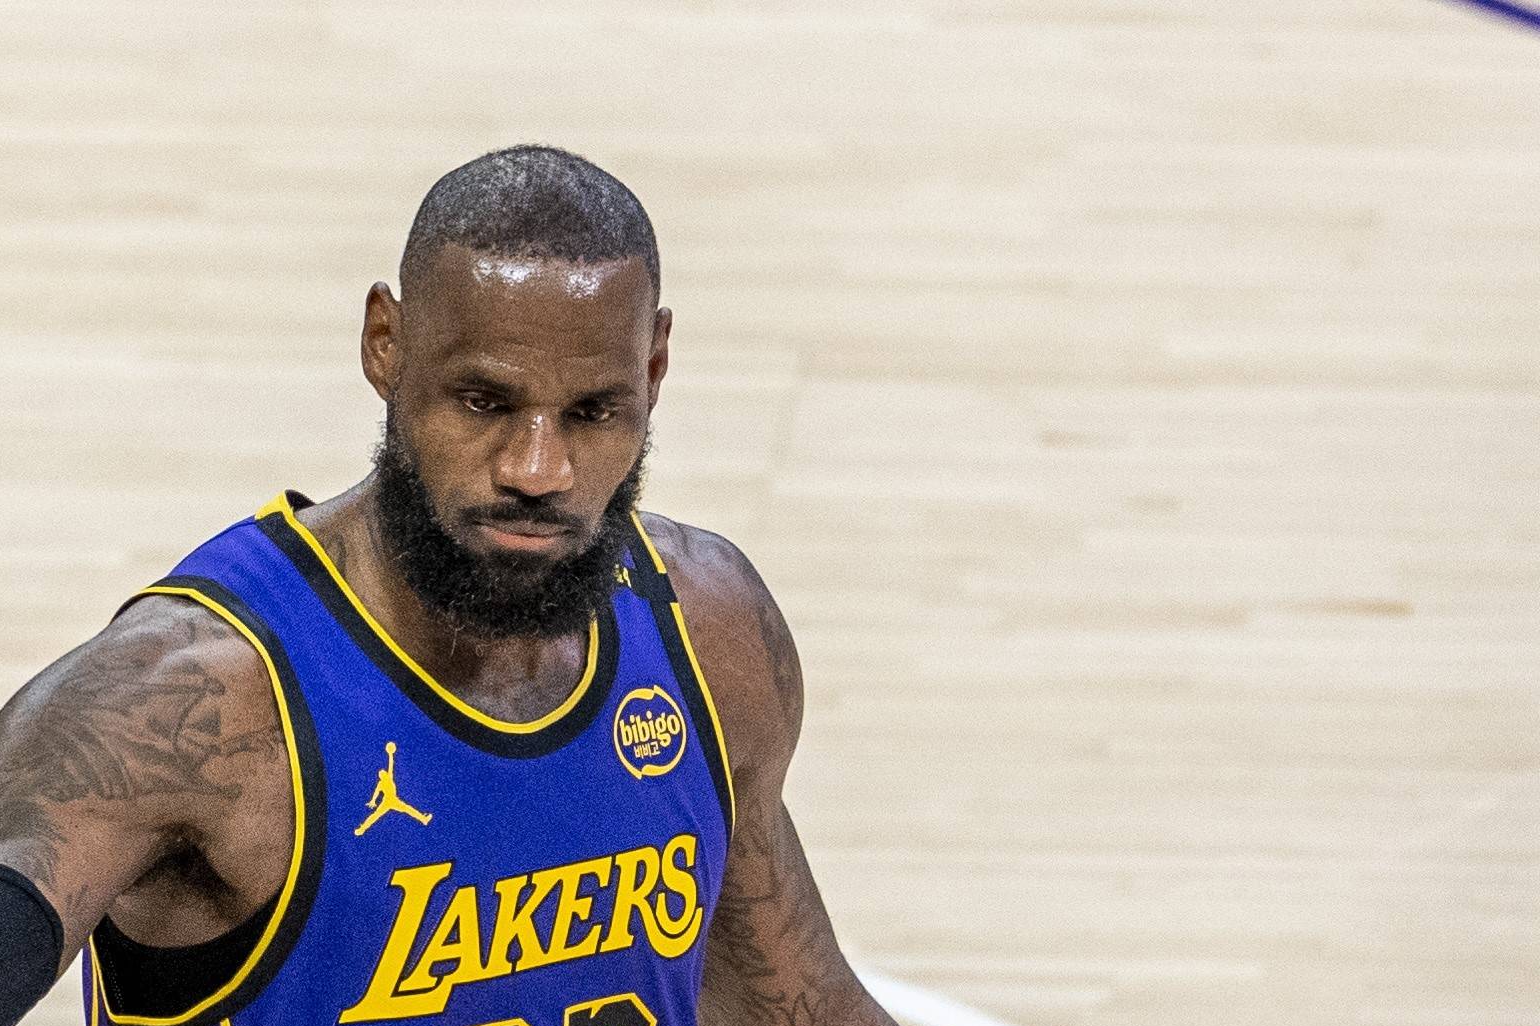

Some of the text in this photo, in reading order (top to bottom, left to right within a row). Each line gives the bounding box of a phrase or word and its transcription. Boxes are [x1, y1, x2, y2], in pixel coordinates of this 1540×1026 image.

[619, 710, 681, 748] bibigo
[633, 741, 661, 759] 비비고
[337, 833, 703, 1025] LAKERS
